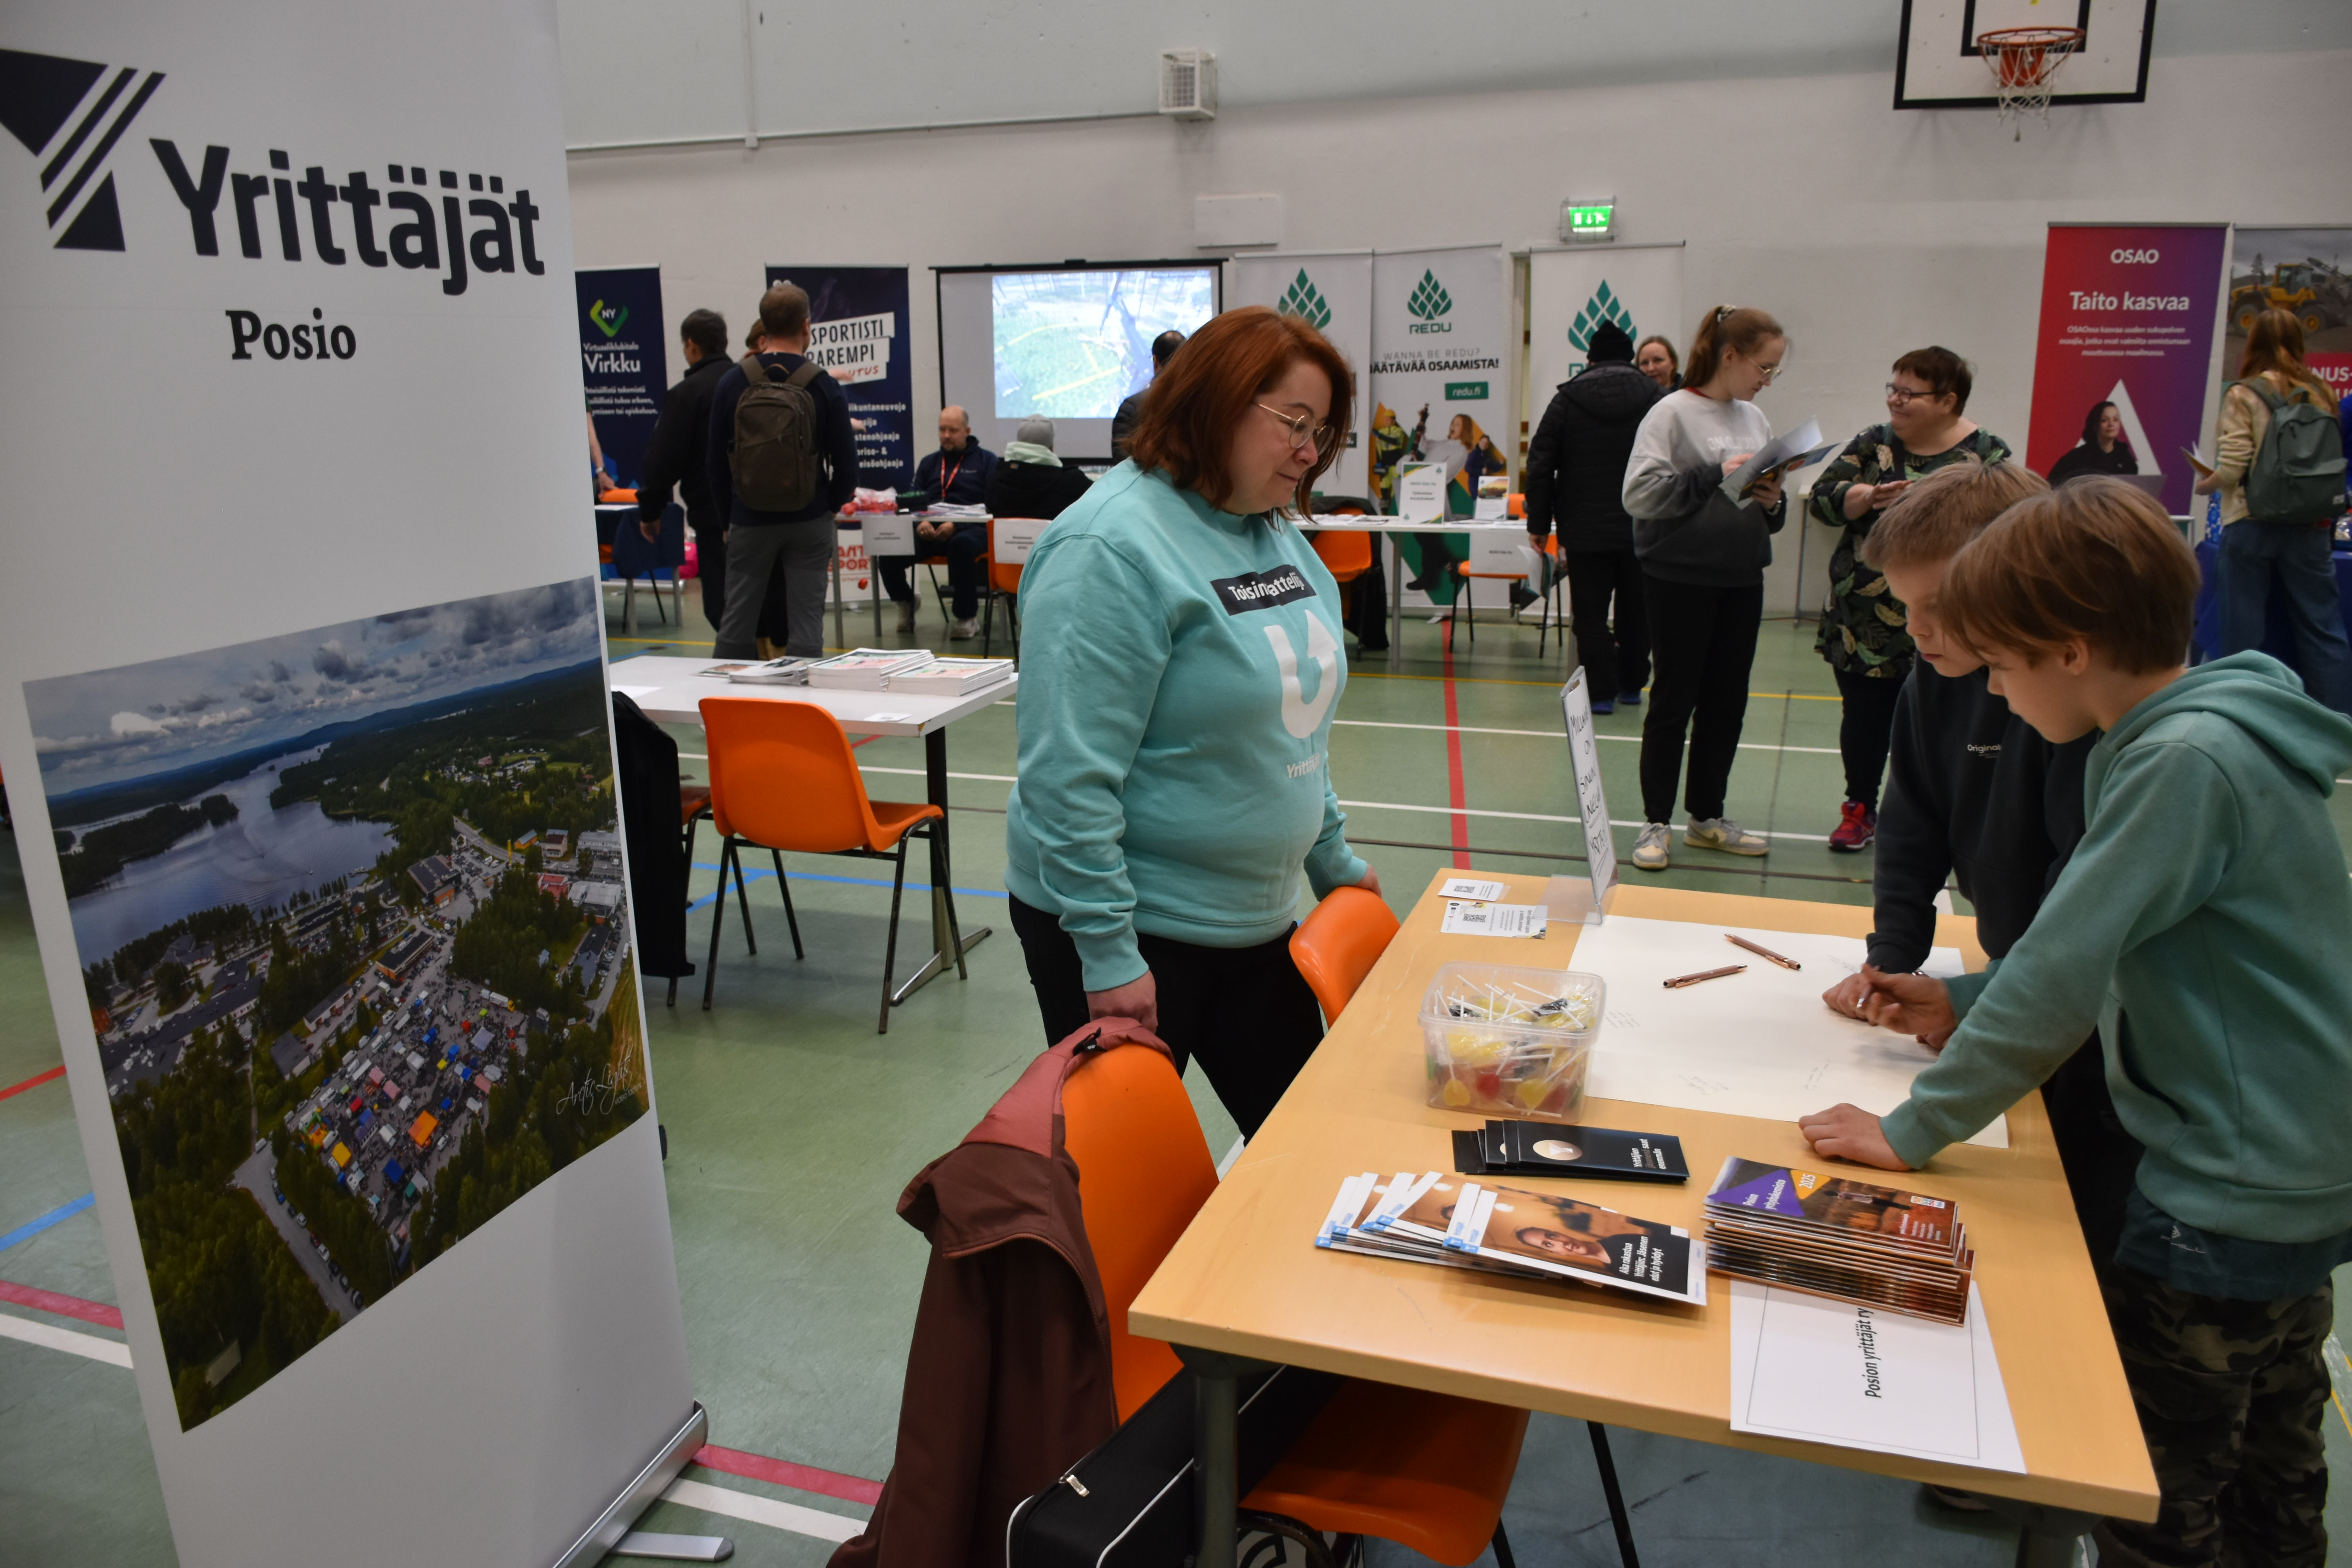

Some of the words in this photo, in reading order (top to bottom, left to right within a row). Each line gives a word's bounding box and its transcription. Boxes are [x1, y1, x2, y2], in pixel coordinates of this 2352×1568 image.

[149, 138, 545, 296] Yrittäjät
[2110, 249, 2159, 264] OSAO
[2070, 291, 2118, 310] Taito
[2122, 291, 2190, 310] kasvaa
[602, 309, 616, 318] NY
[225, 307, 356, 360] Posio
[811, 319, 883, 345] SPORTISTI
[1410, 322, 1452, 334] REDU
[806, 343, 874, 367] PAREMPI
[1383, 351, 1422, 360] WANNA
[1427, 350, 1439, 358] BE
[1445, 348, 1480, 357] REDU?
[584, 353, 641, 373] Virkku
[1428, 358, 1499, 371] OSAAMISTA!
[1452, 386, 1481, 396] redu.fi
[1639, 1138, 1650, 1149] saat
[1631, 1147, 1643, 1168] Yrittäjien
[1653, 1148, 1667, 1170] enemmän
[1798, 1173, 1816, 1189] 2025
[1742, 1193, 1759, 1206] Posion
[1621, 1242, 1633, 1264] rakastua
[1636, 1236, 1648, 1257] Jäsenen
[1651, 1248, 1664, 1265] hyödyt
[1619, 1264, 1630, 1274] Aika
[1649, 1270, 1659, 1281] edut
[1857, 1307, 1875, 1319] ry
[1855, 1319, 1882, 1361] yrittäjät
[1862, 1362, 1882, 1398] Posion
